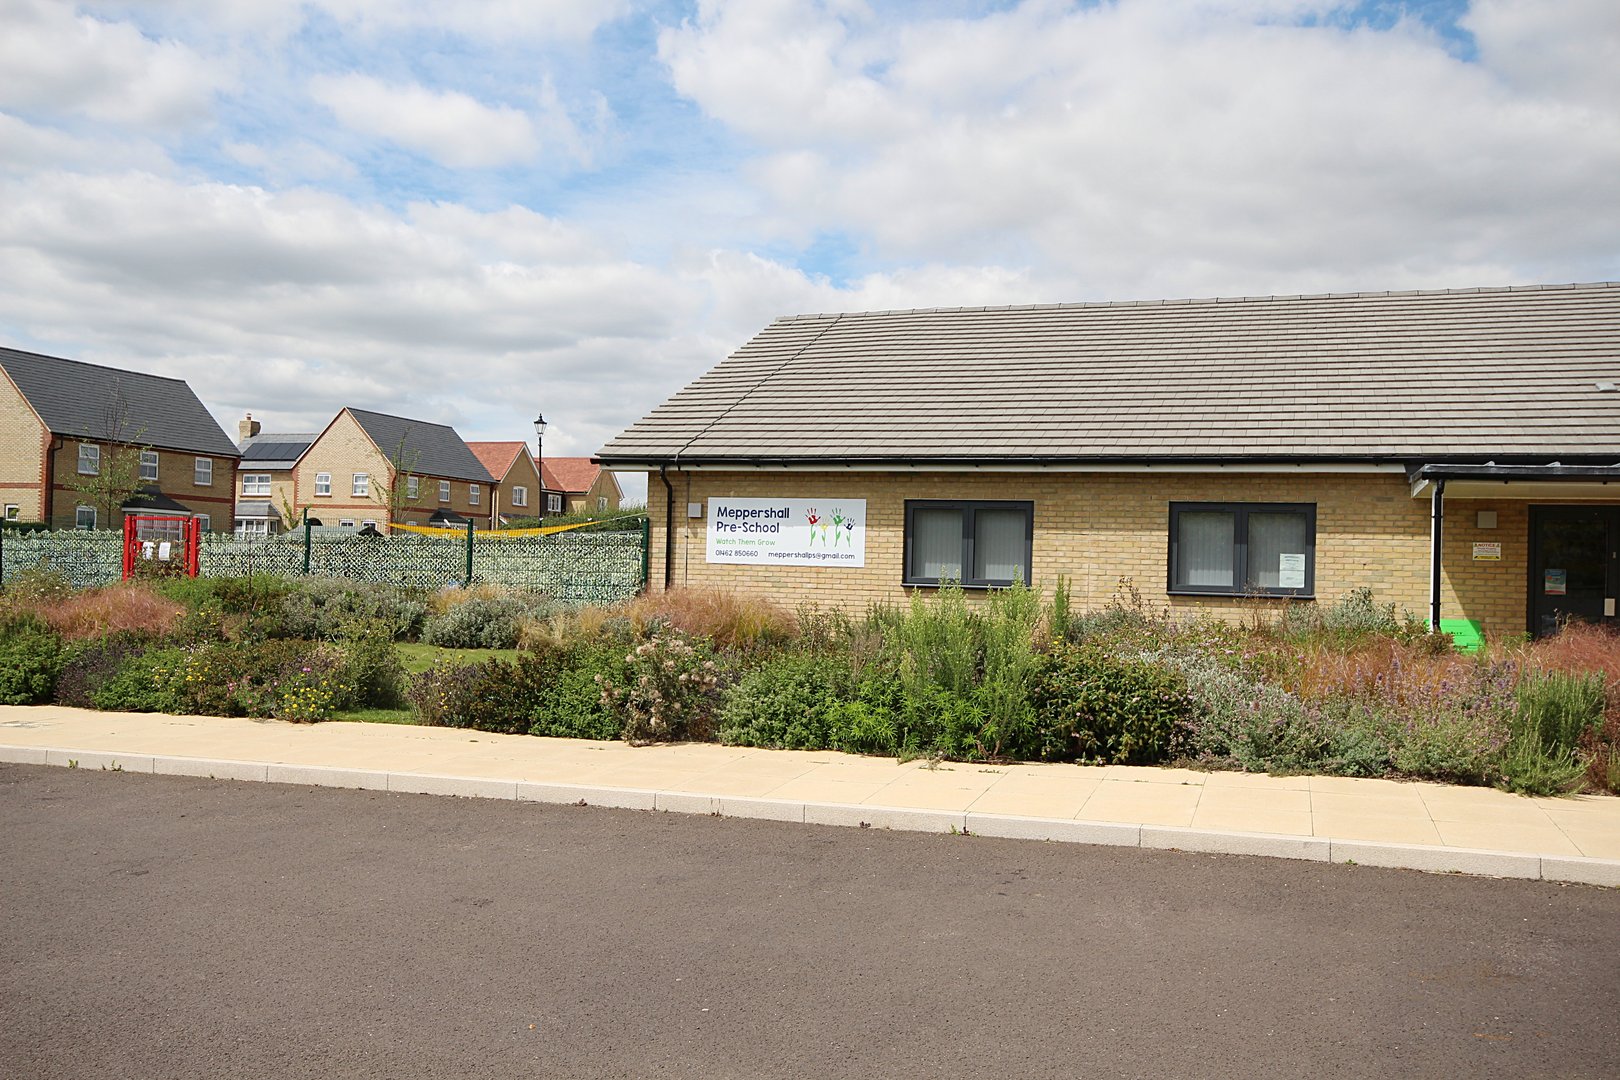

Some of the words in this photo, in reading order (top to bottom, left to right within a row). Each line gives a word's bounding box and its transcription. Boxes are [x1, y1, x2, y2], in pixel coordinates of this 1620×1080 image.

[717, 506, 790, 520] Meppershall
[716, 521, 780, 533] Pre-School
[738, 538, 756, 546] Them
[768, 551, 855, 560] meppershallps@gmail.com
